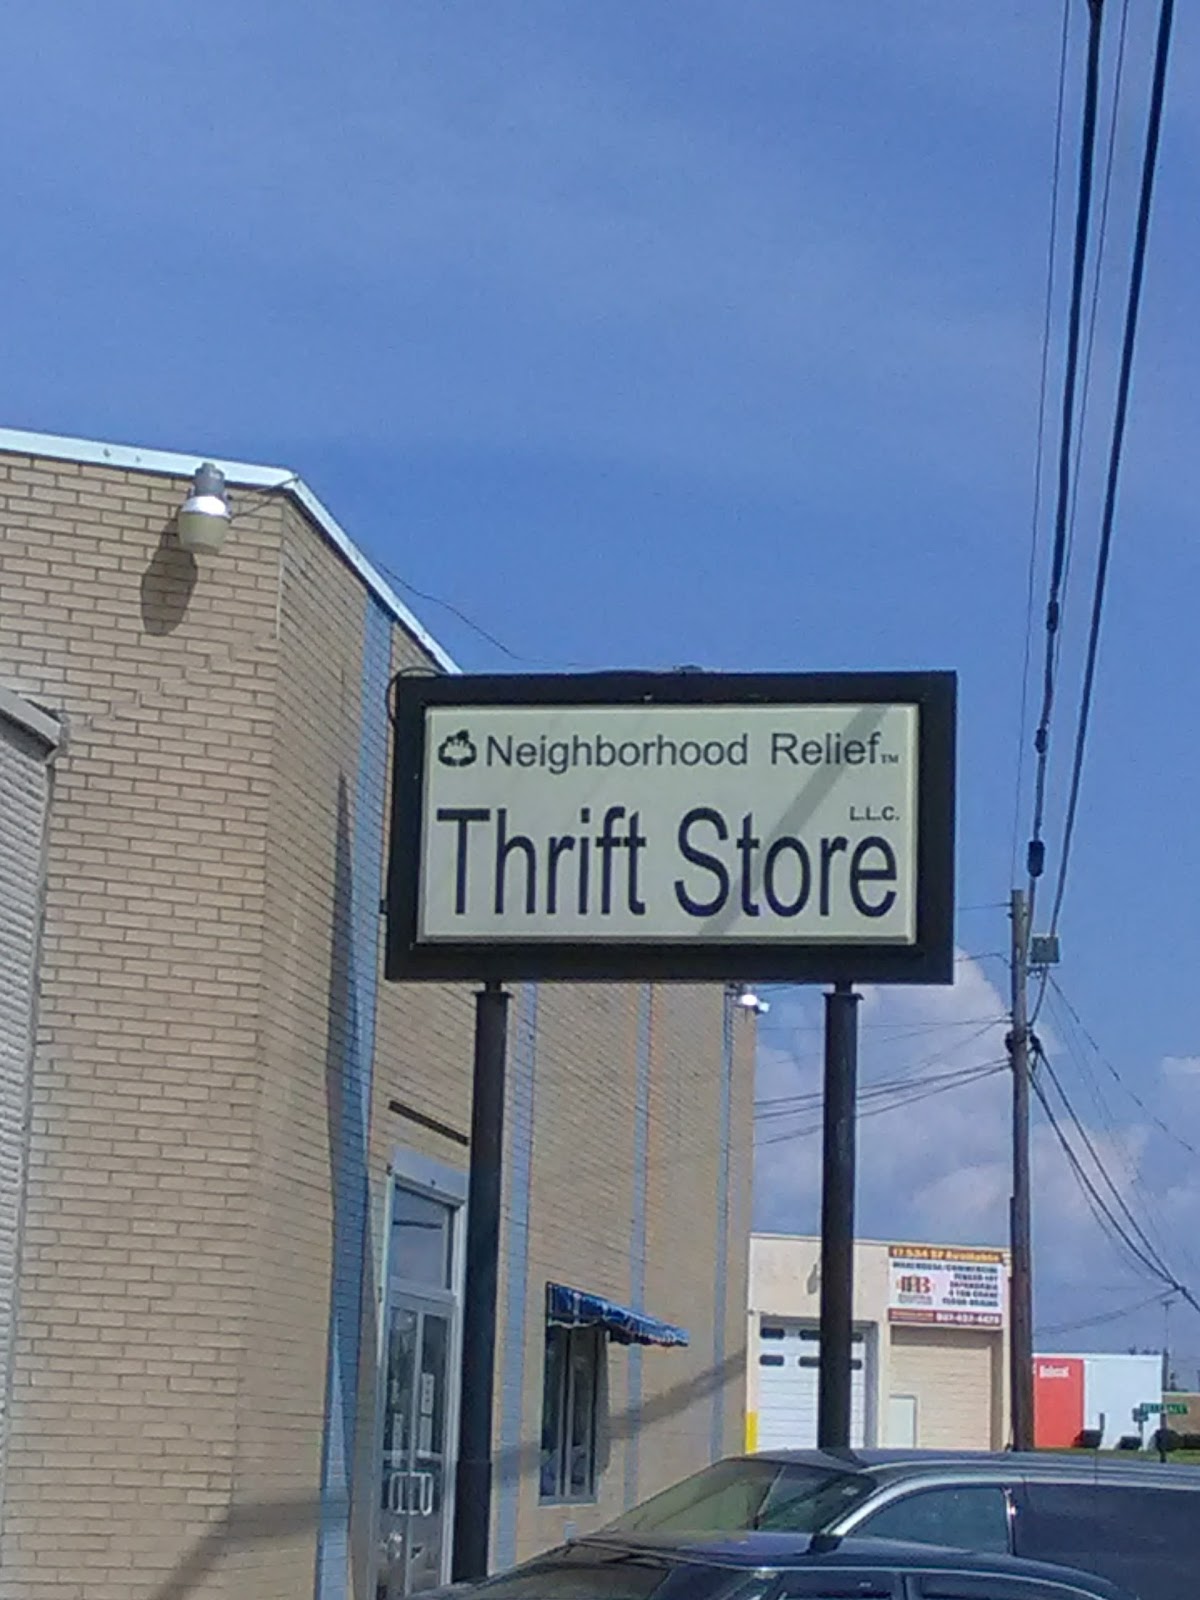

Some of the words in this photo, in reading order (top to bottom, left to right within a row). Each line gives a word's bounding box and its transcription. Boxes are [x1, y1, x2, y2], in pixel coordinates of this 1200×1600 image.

[486, 733, 748, 774] Neighborhood
[770, 732, 881, 766] Relief
[436, 806, 646, 915] Thrift
[674, 806, 898, 917] Store
